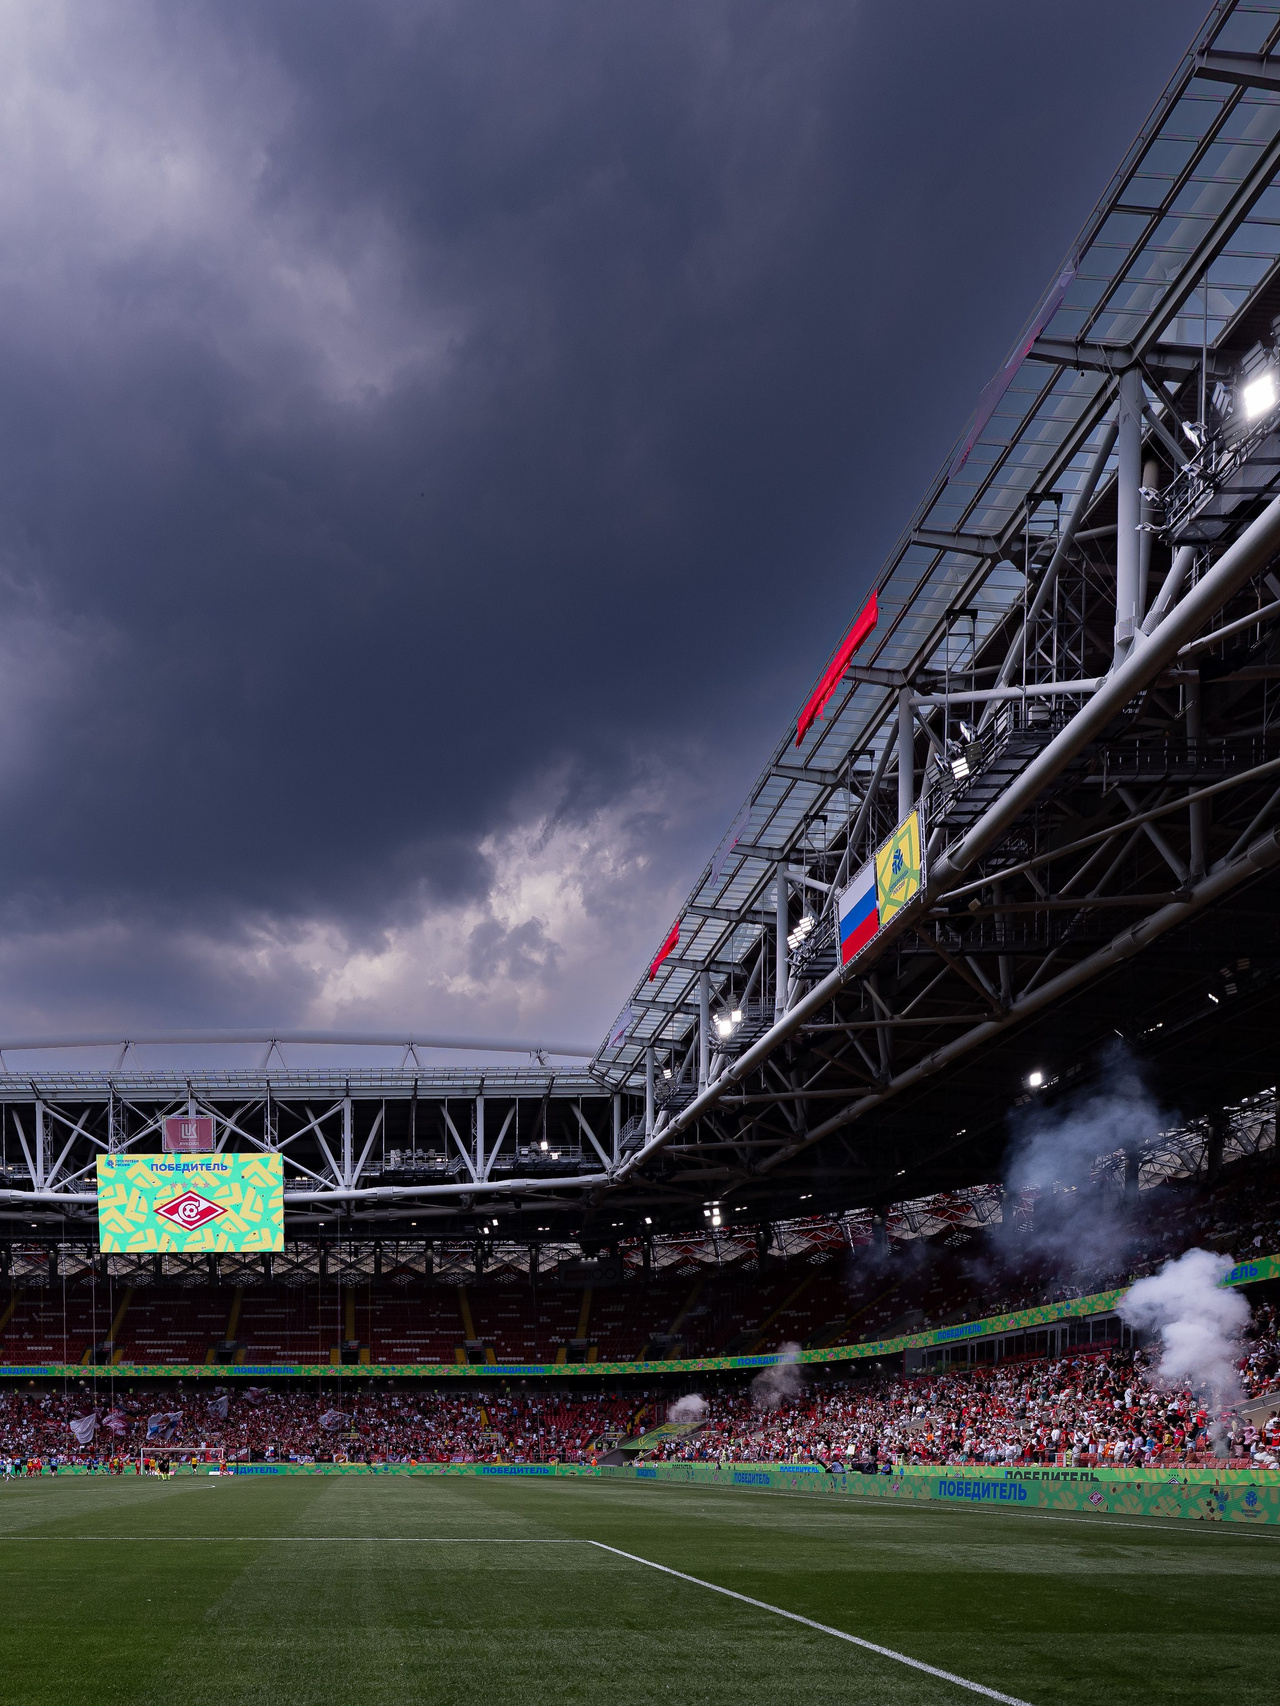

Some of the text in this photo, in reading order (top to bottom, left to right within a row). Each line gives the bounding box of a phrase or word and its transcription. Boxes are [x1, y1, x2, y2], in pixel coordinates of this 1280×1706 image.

[150, 1163, 228, 1174] ПОБЕДИТЕЛЬ
[937, 1323, 982, 1340] ПОБЕДИТЕЛЬ
[483, 1366, 545, 1374] ПОБЕДИТЕЛЬ
[483, 1466, 549, 1475] ПОБЕДИТЕЛЬ
[734, 1472, 770, 1485] ПОБЕДИТЕЛЬ
[938, 1480, 1028, 1501] ПОБЕДИТЕЛЬ
